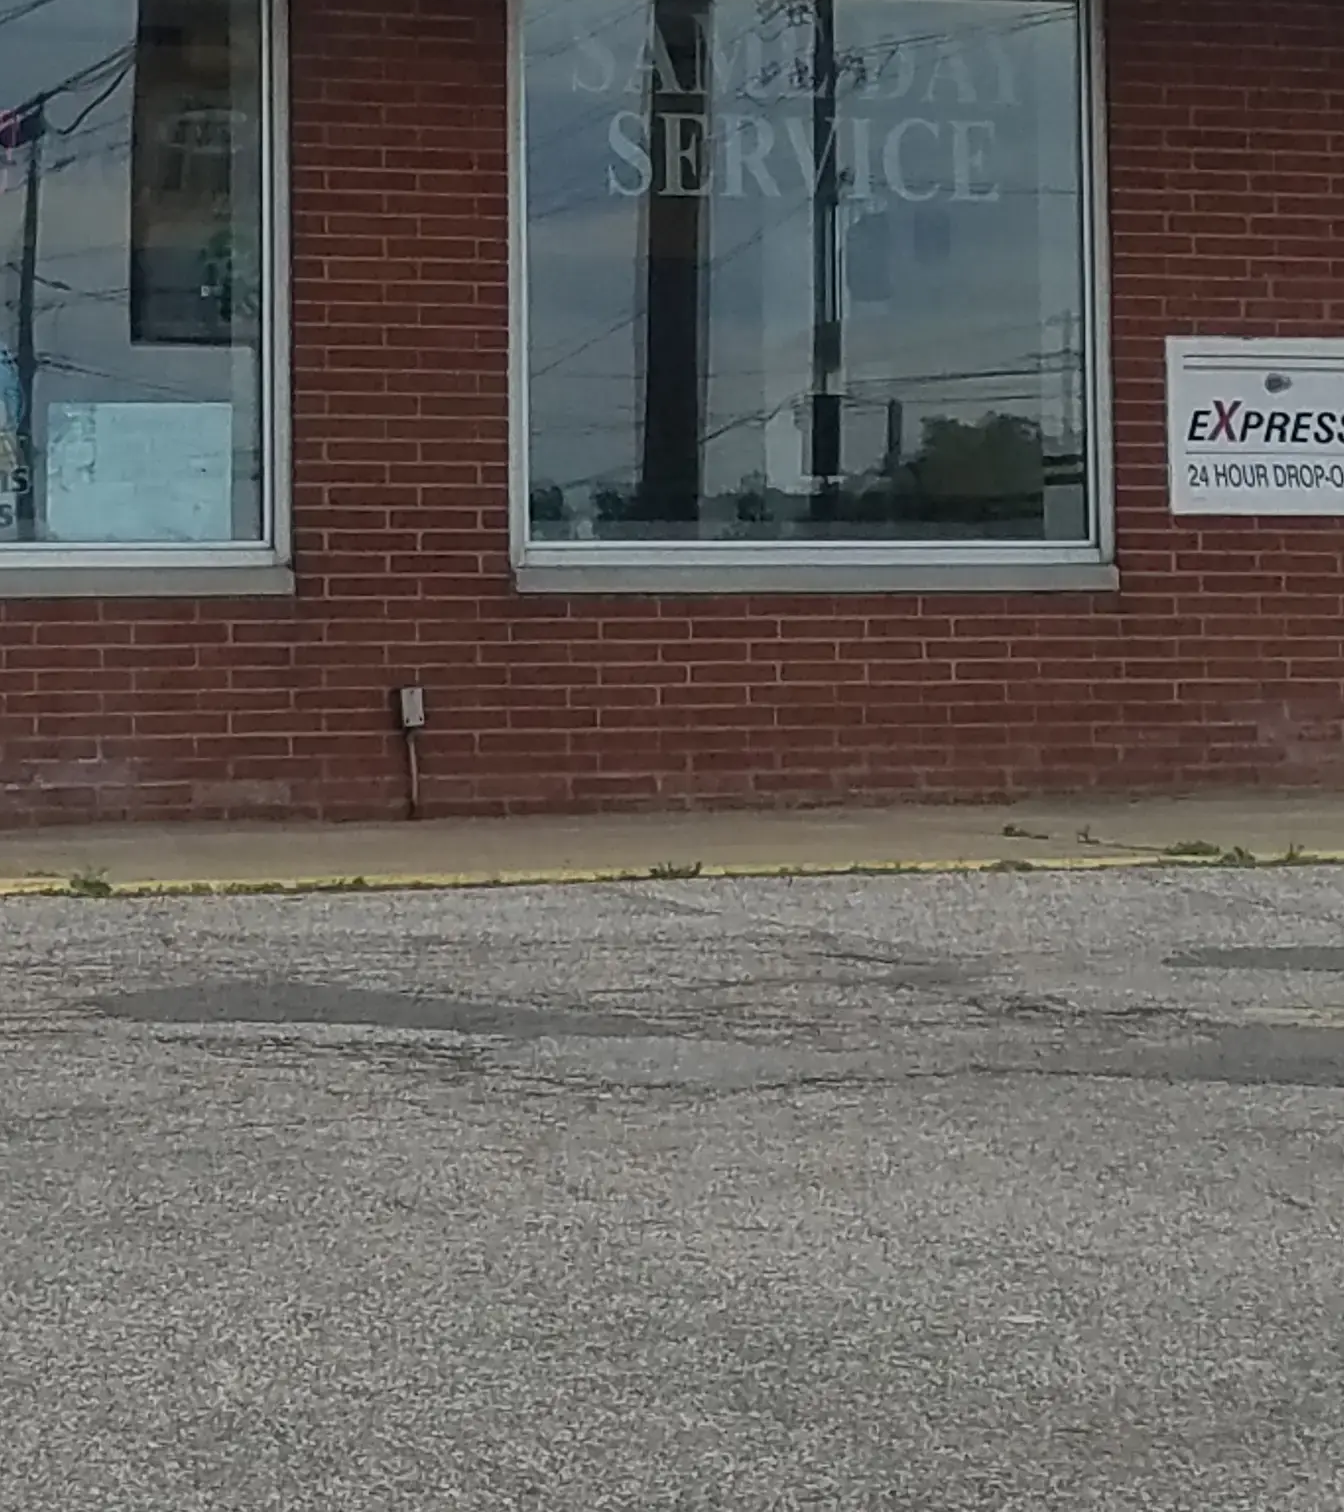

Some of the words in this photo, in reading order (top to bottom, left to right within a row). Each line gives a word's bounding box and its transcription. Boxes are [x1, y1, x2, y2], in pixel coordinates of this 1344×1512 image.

[606, 109, 1000, 203] SERVICE
[1187, 464, 1208, 488] 24
[1213, 464, 1270, 488] HOUR
